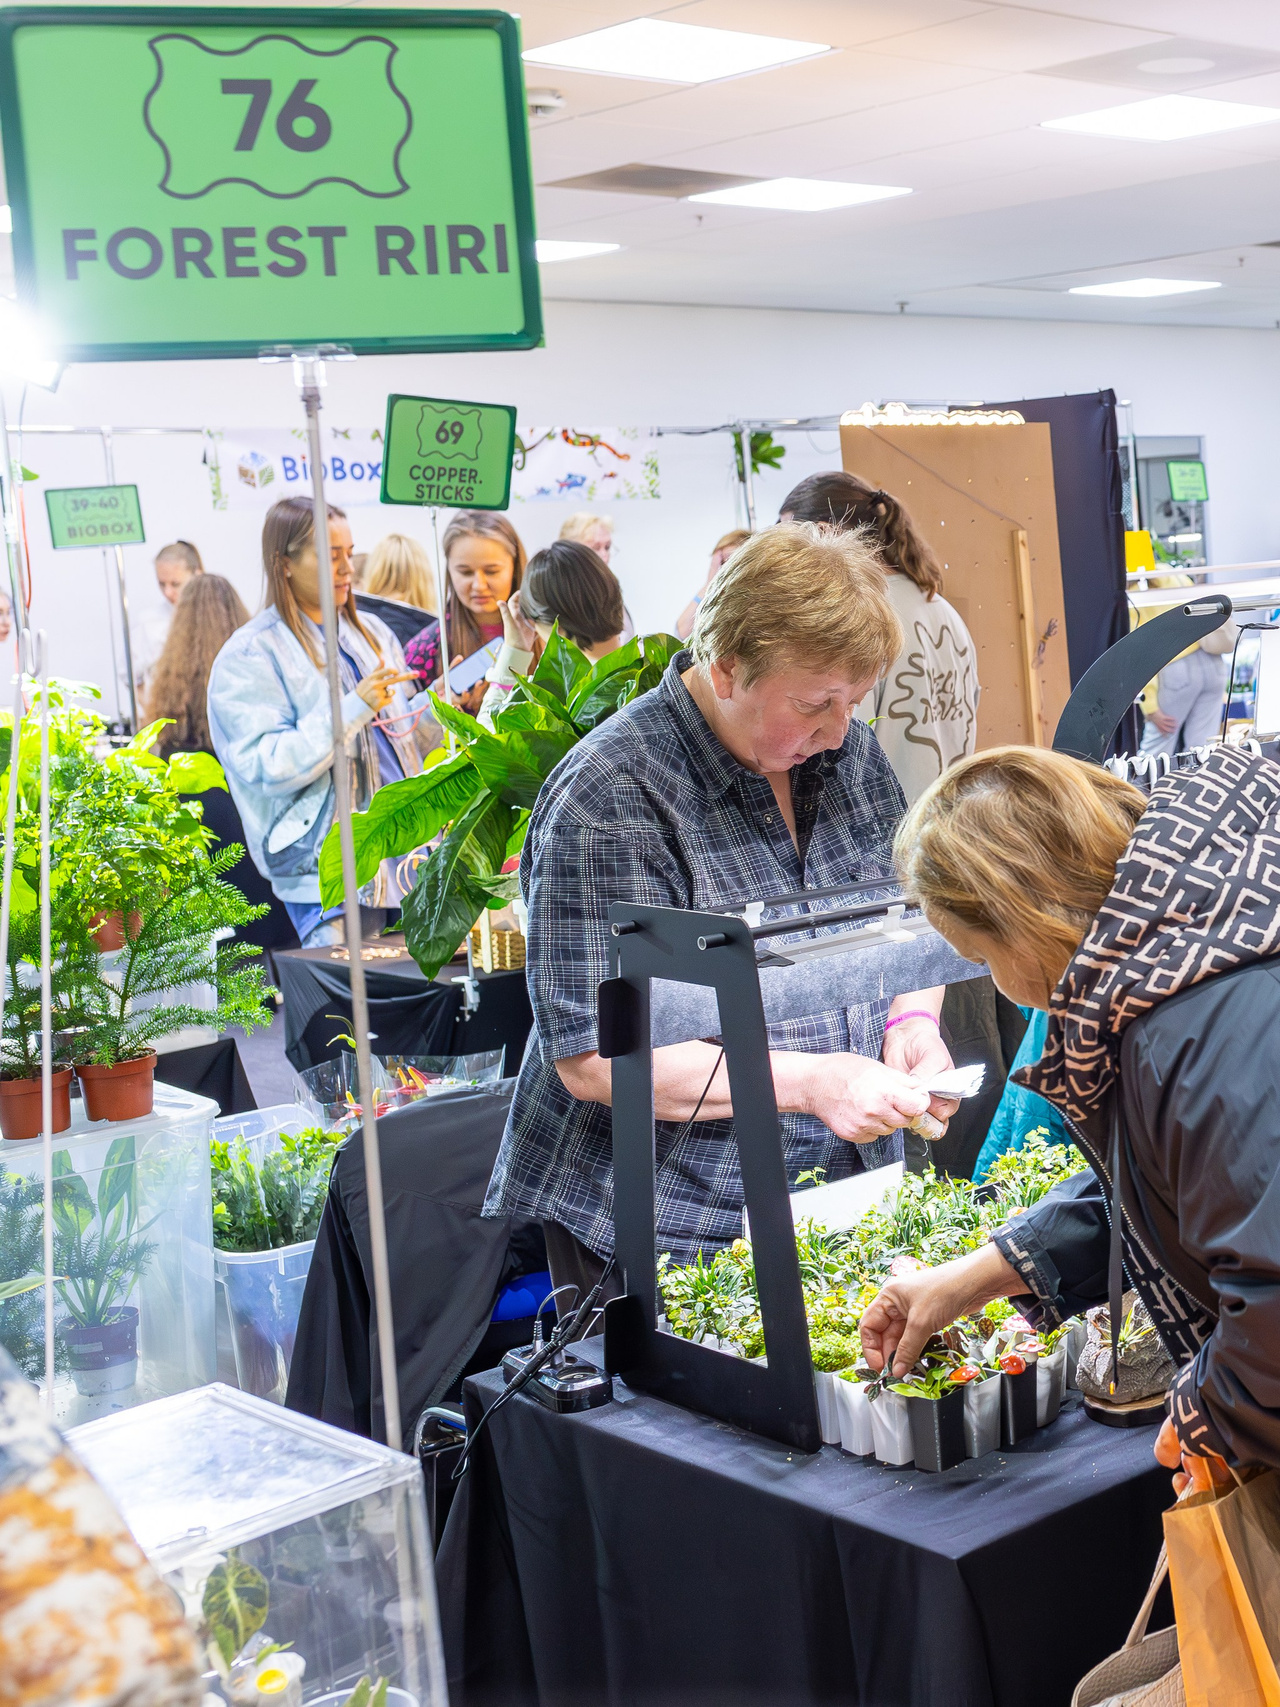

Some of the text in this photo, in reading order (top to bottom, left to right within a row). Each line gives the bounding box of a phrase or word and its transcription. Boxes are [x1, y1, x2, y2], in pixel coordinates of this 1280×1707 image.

[220, 78, 332, 153] 76
[61, 223, 510, 280] FOREST RIRI
[435, 420, 464, 445] 69
[409, 465, 483, 484] COPPER.
[415, 484, 474, 501] STICKS
[67, 522, 135, 539] BIOBOX
